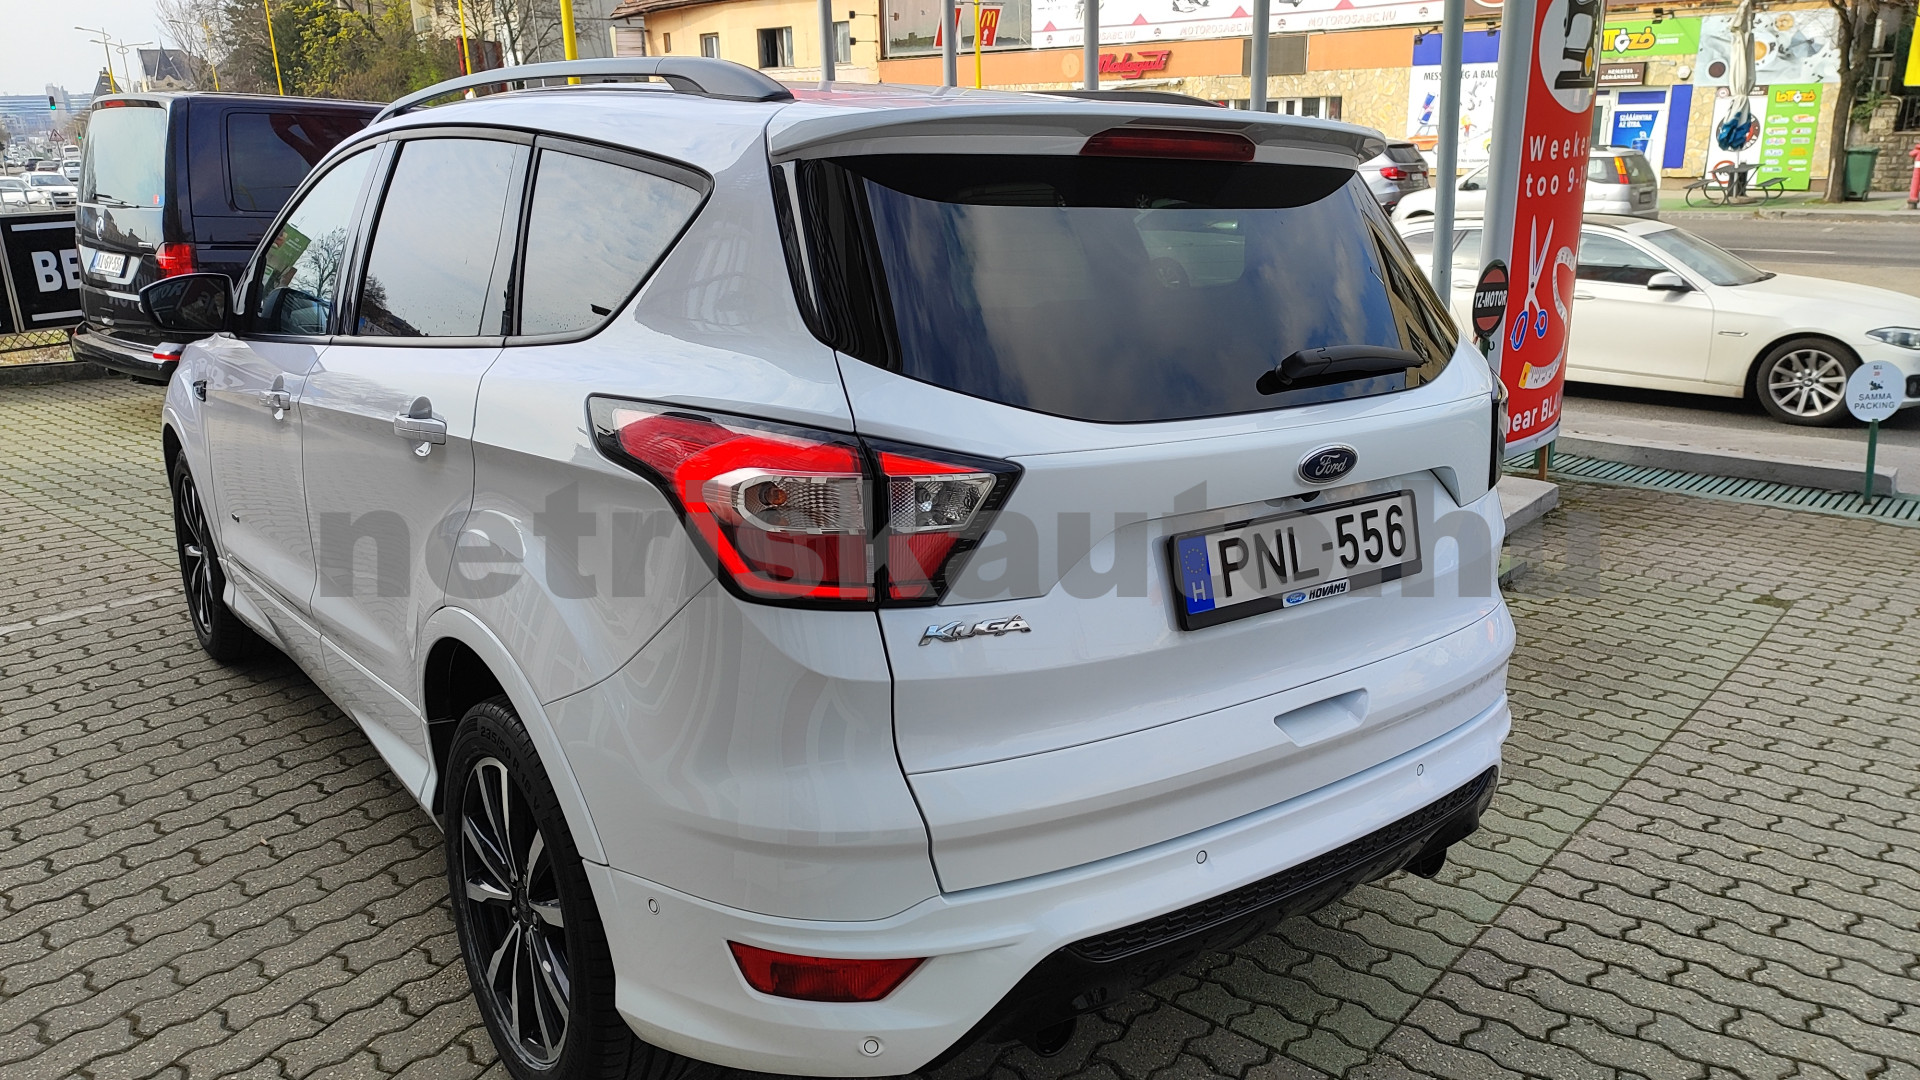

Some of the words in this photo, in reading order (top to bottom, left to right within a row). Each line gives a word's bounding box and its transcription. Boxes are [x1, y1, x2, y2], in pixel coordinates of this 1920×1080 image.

[1526, 173, 1559, 198] too
[1474, 290, 1508, 308] TZ-MOTOR
[1854, 401, 1895, 410] PACKING
[1858, 392, 1892, 401] SAMMA
[1315, 453, 1347, 476] Ford
[1218, 504, 1407, 598] PNL-556
[918, 614, 1032, 647] KUGA
